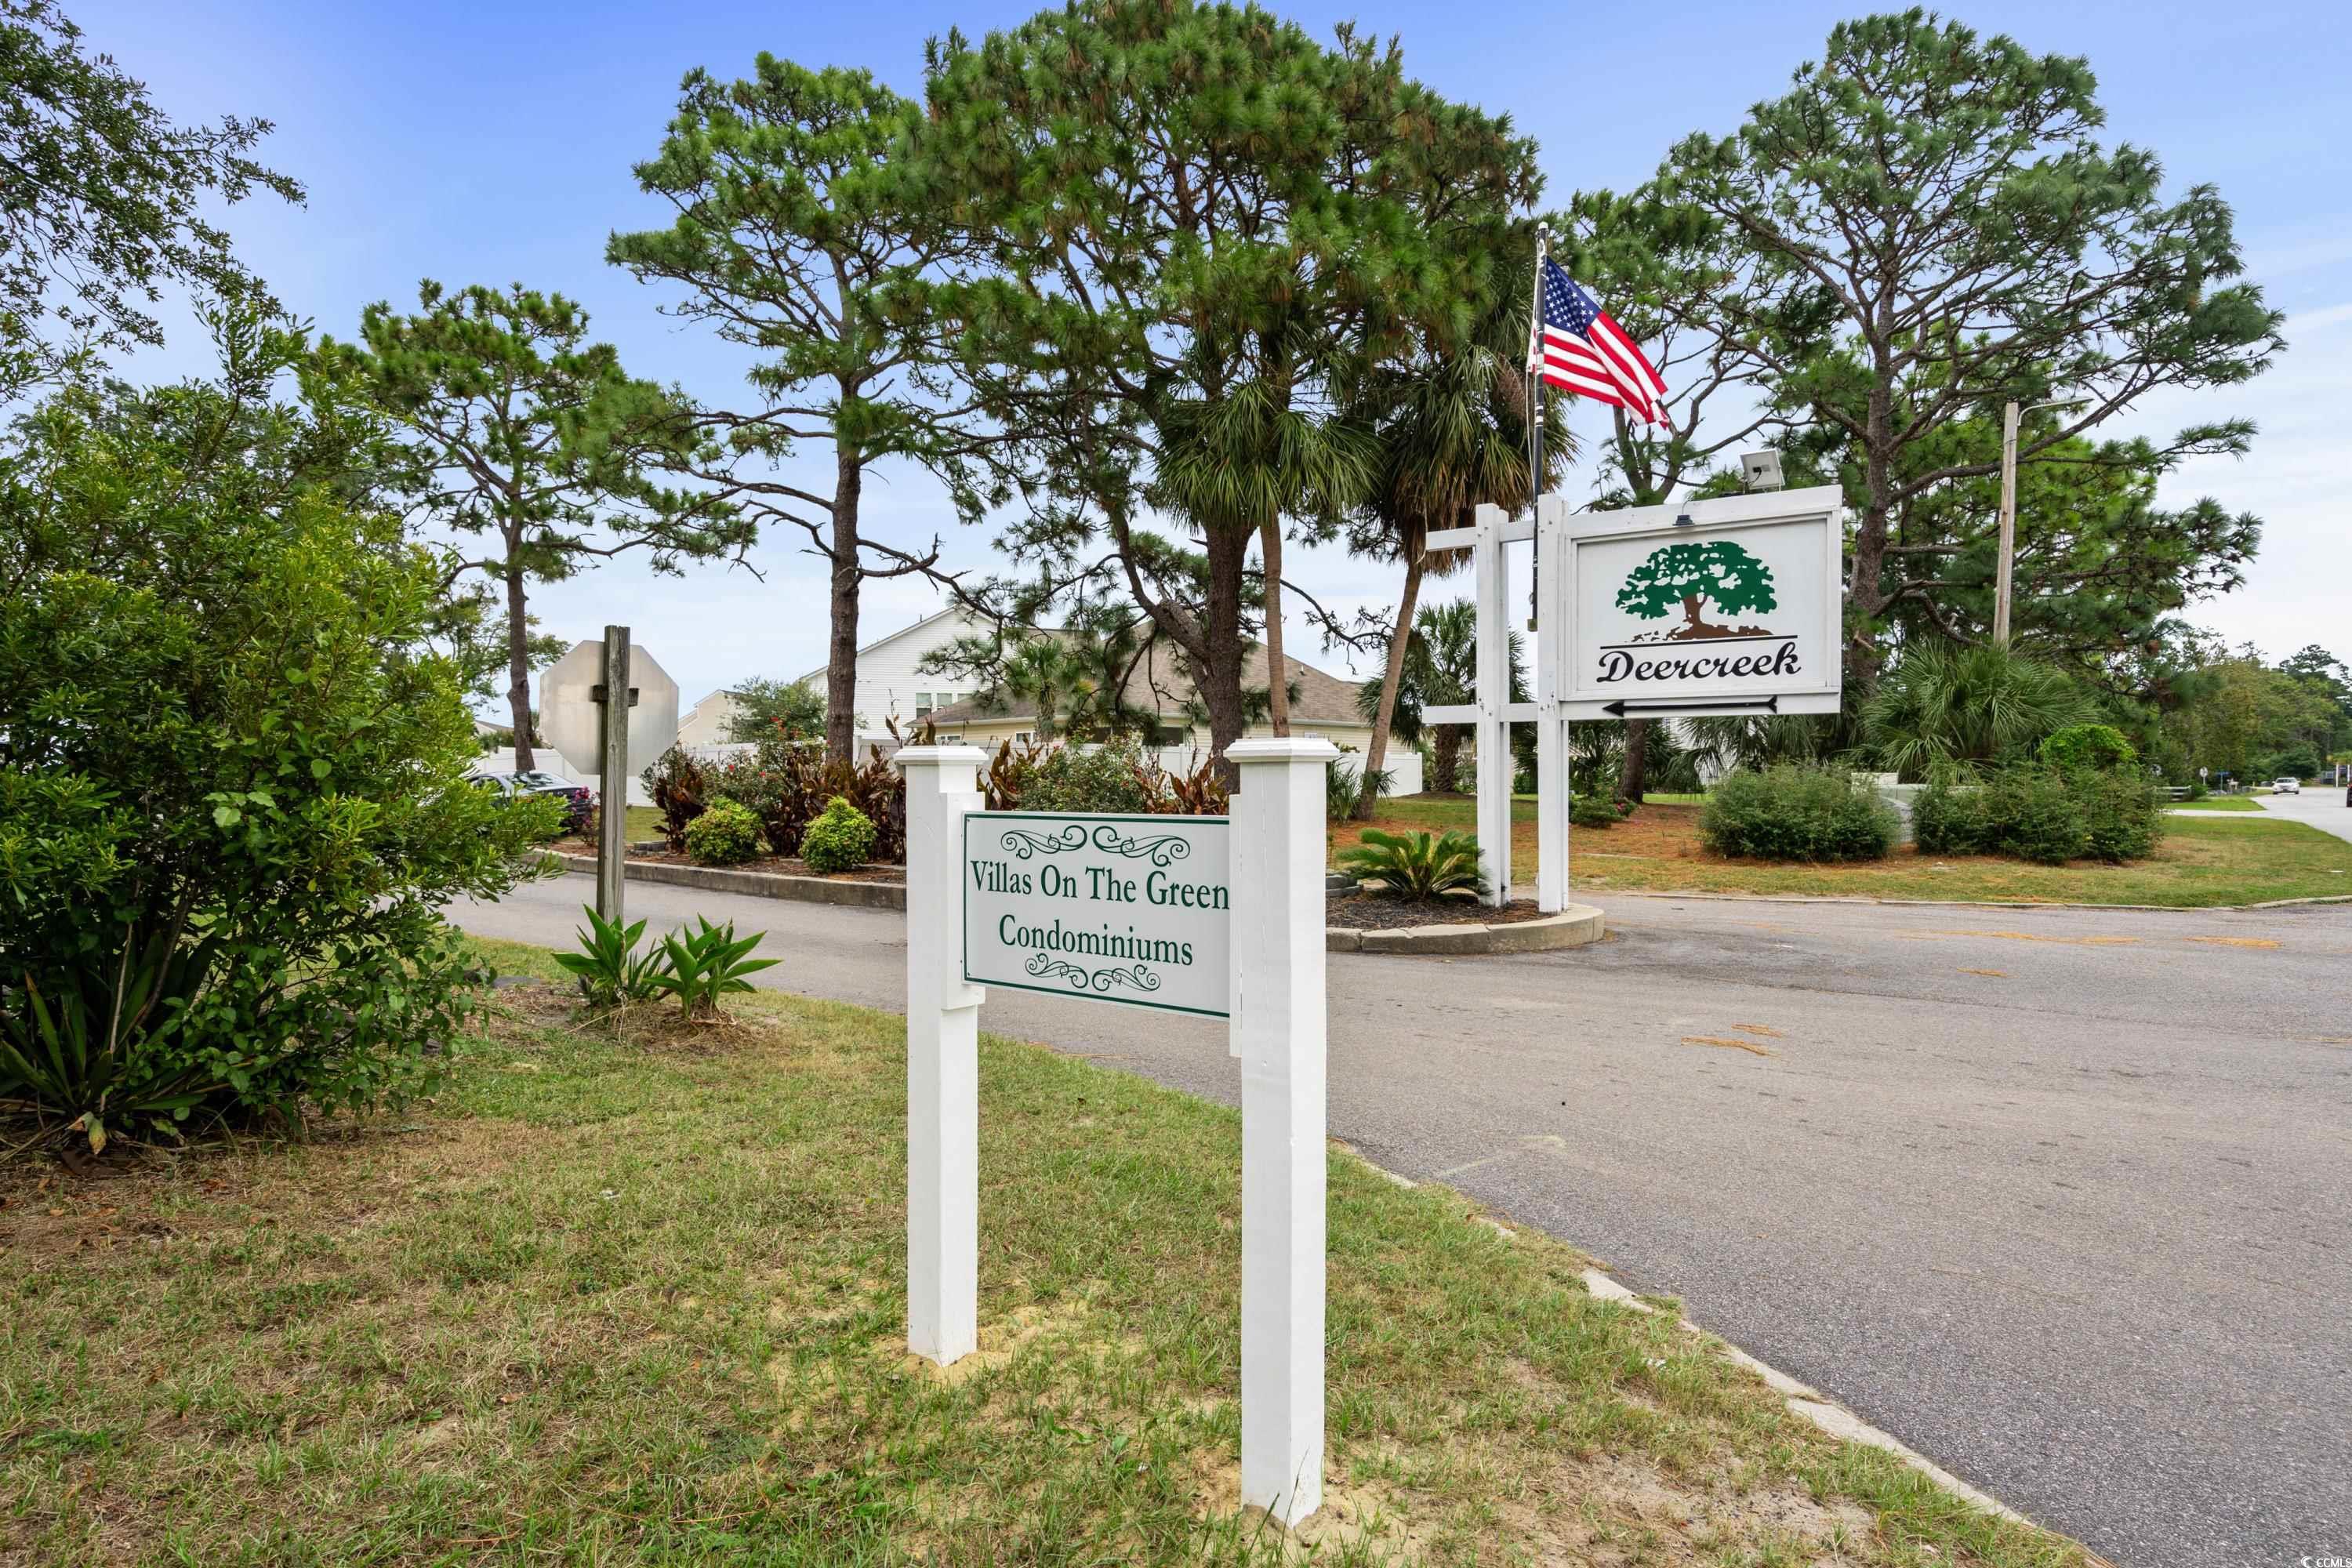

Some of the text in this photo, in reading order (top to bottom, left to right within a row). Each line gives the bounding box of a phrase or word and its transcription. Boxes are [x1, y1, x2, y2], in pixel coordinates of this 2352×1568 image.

[1596, 641, 1801, 683] Deercreek
[970, 860, 1230, 910] Villas On The Green
[999, 914, 1192, 966] Condominiums
